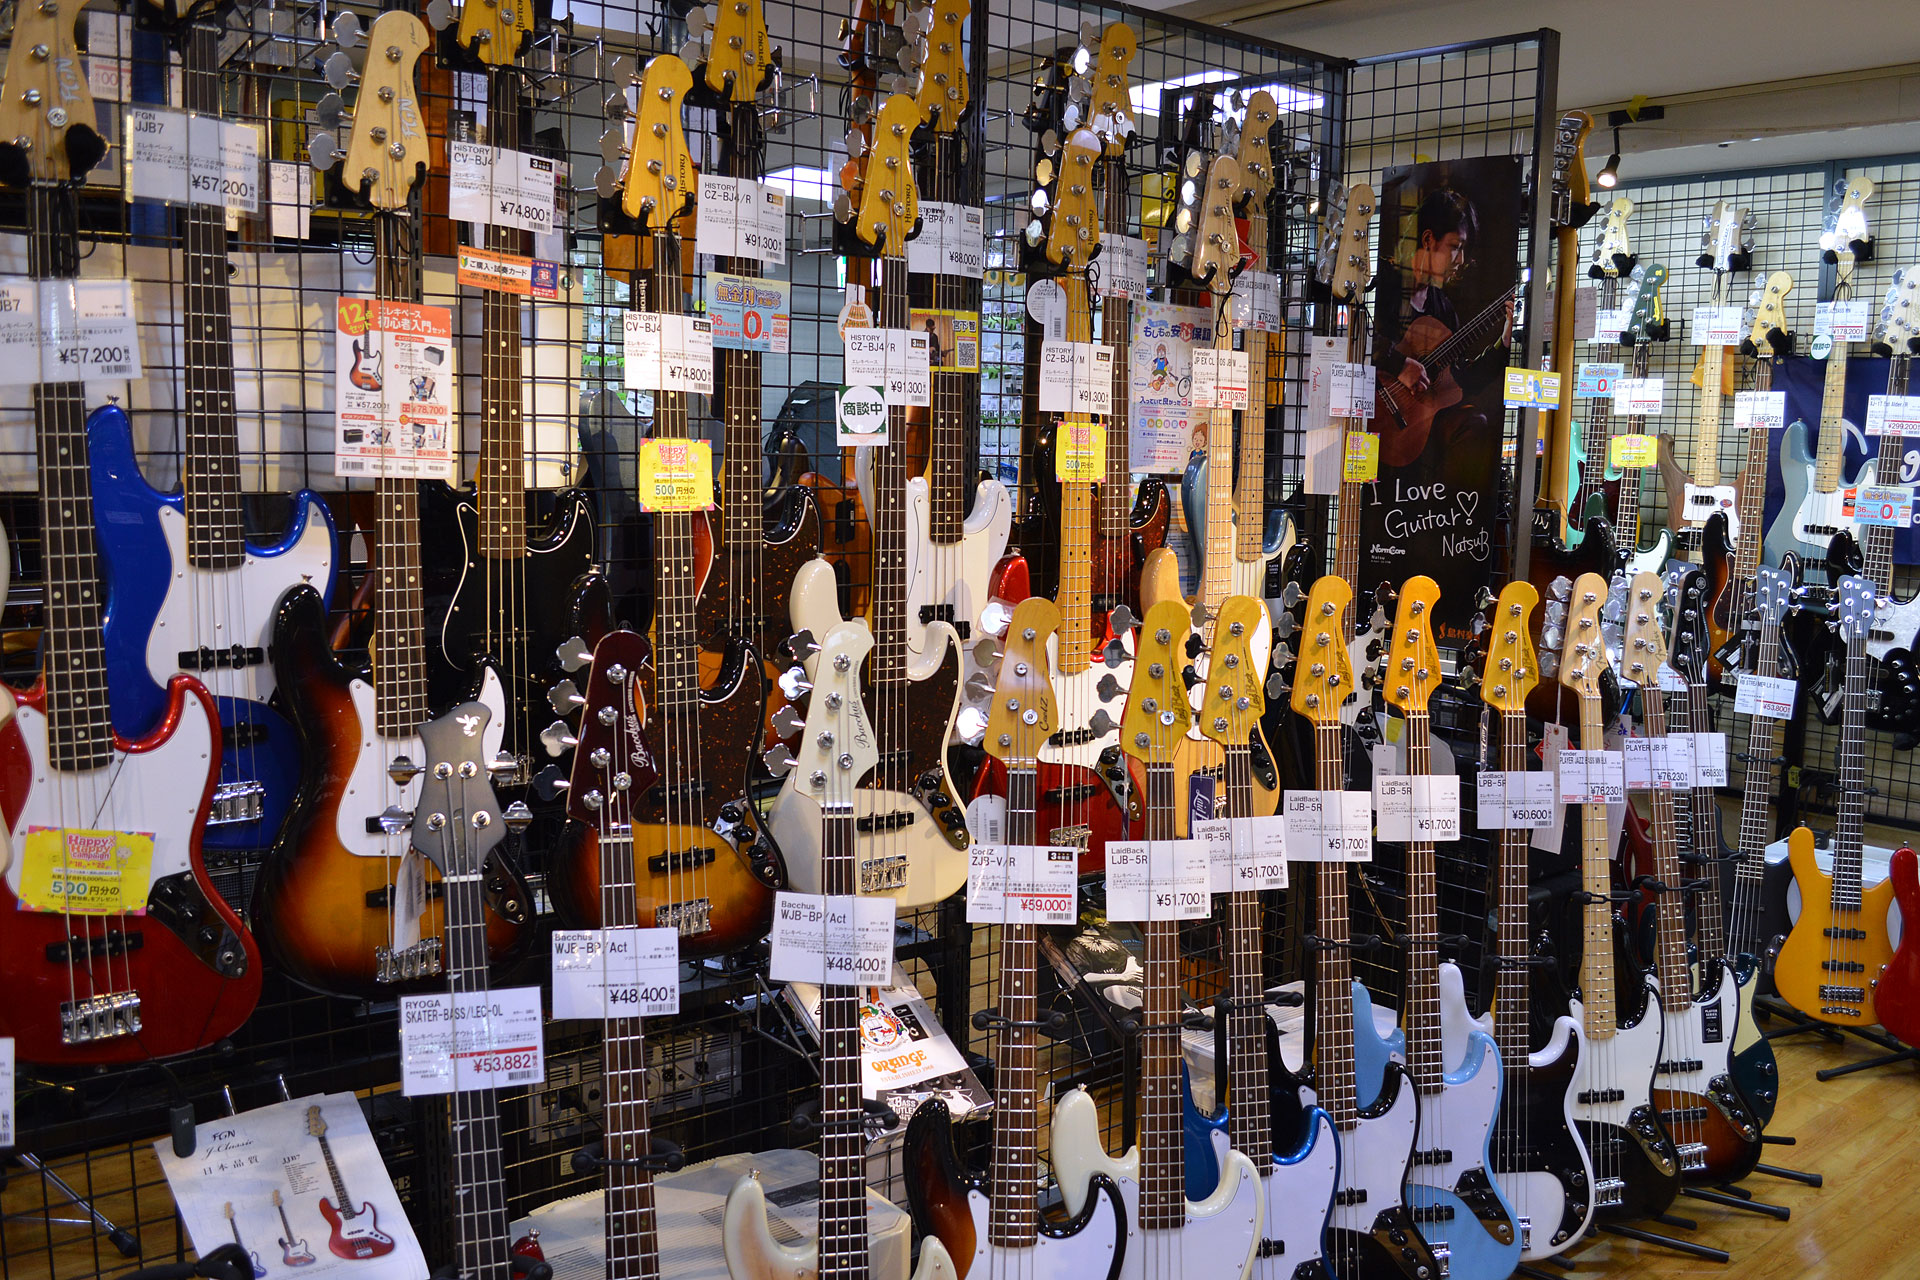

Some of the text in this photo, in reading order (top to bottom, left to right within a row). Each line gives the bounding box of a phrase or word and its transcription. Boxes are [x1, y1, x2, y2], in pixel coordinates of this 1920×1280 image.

[516, 0, 526, 33] HISTO
[757, 31, 765, 72] HISTORY
[135, 111, 156, 120] FGN
[135, 121, 164, 134] JJB7
[454, 145, 490, 155] HISTORY
[454, 152, 493, 166] CV-BJ4
[678, 153, 688, 197] HISTORY
[191, 174, 248, 198] ¥57,200
[704, 182, 736, 191] HISTORY
[704, 190, 751, 204] CZ-BJ4/R
[905, 184, 913, 223] HISTORY
[500, 201, 545, 221] ¥74,800
[745, 233, 778, 251] ¥91,300
[949, 251, 977, 266] ¥88,000
[717, 284, 755, 306] 無金利
[377, 307, 421, 319] エレキベース
[625, 314, 658, 322] HISTORY
[377, 317, 447, 334] 初心者入門セット
[625, 322, 661, 333] CV-BJ4
[1143, 324, 1211, 342] もしもの安心保証
[851, 342, 896, 352] CZ-BJ4/R
[58, 347, 122, 364] ¥57,200
[1045, 354, 1085, 364] CZ-BJ4/M
[669, 366, 707, 382] ¥74,800
[890, 381, 922, 394] ¥91,300
[842, 402, 883, 416] 商談中
[655, 485, 674, 495] 500
[1369, 478, 1447, 505] I Love
[1370, 544, 1406, 555] NormCore
[1763, 704, 1788, 713] ¥53,800
[848, 700, 871, 749] Bacchus
[624, 714, 650, 768] Bacchus
[1657, 772, 1688, 782] ¥76,230
[1381, 787, 1412, 795] LJB-5R
[1591, 787, 1619, 796] ¥76,230
[1290, 803, 1322, 812] LJB-5R
[1512, 809, 1548, 820] ¥50,600
[1418, 819, 1452, 830] ¥51,700
[68, 835, 109, 847] Happy
[1328, 838, 1364, 850] ¥51,700
[70, 845, 110, 855] Happy
[972, 856, 1016, 867] ZJB-V/R
[1111, 855, 1148, 864] LJB-5R
[1240, 865, 1279, 879] ¥51,700
[52, 881, 120, 896] 500 円分の
[781, 901, 816, 910] Bacchus
[1020, 899, 1066, 912] ¥59,000
[1156, 893, 1200, 906] ¥51,700
[781, 909, 846, 924] WJB-BP/Act
[554, 933, 593, 942] Bacchus
[555, 942, 628, 955] WJB-BP/Act
[826, 956, 880, 972] ¥48,400
[610, 986, 668, 1004] ¥48,400
[405, 1000, 441, 1010] RYOGA
[406, 1004, 503, 1024] SKATER-BASS/LEC-OL
[473, 1054, 531, 1074] ¥53,882
[871, 1050, 927, 1073] ORANGE
[880, 1067, 921, 1083] ESTABLISHED
[212, 1130, 236, 1142] FGN
[203, 1155, 259, 1175] 日本品質
